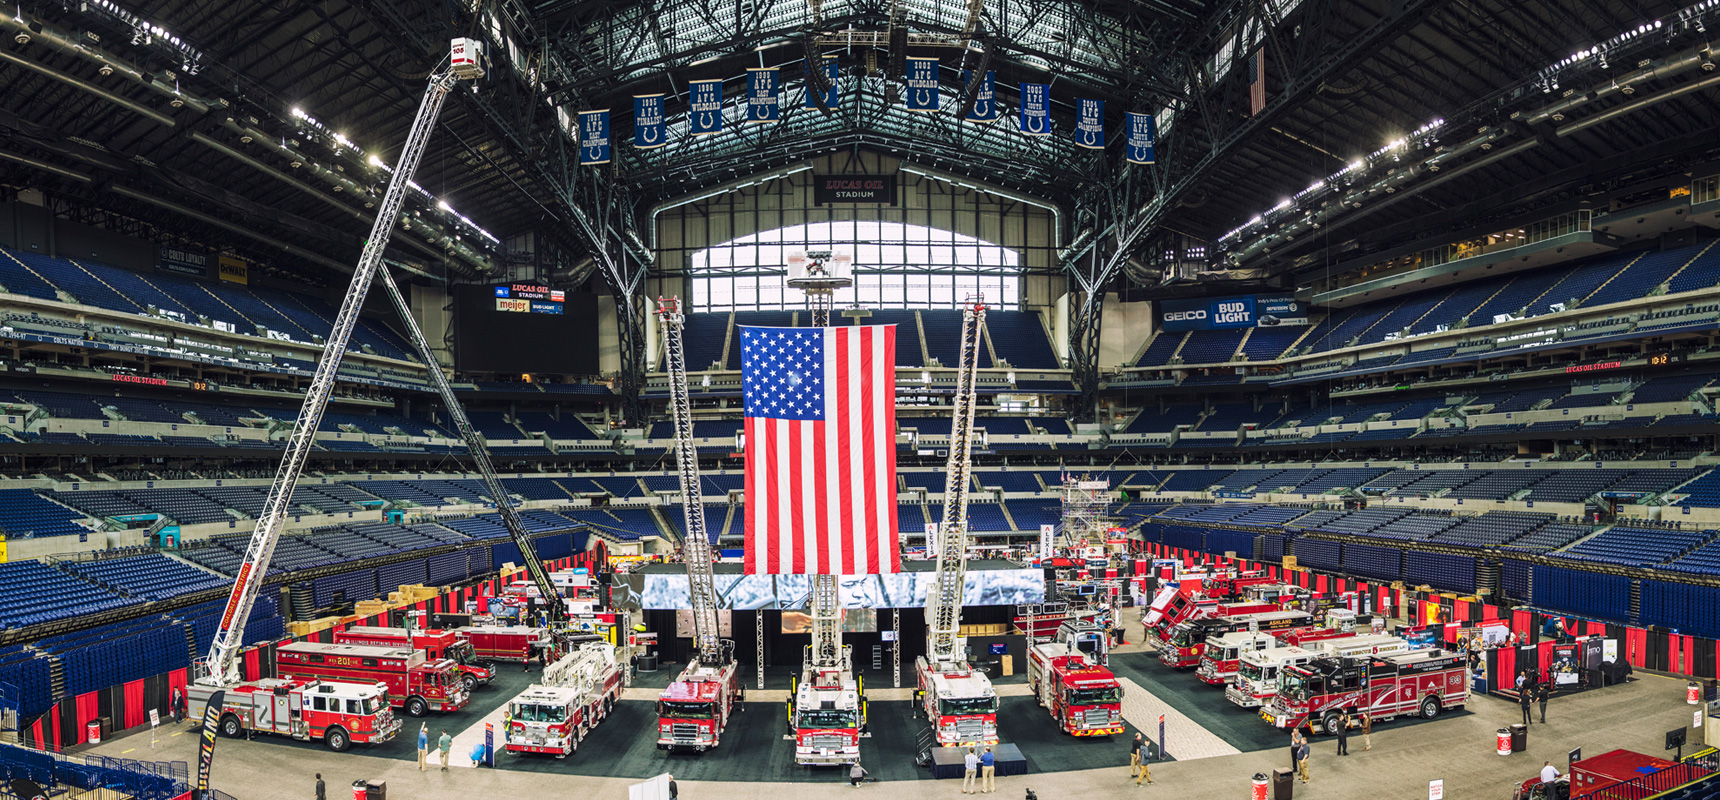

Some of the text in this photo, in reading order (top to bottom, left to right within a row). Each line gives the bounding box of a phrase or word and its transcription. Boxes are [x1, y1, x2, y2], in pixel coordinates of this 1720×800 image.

[915, 71, 930, 80] AFC
[754, 79, 771, 90] AFC
[908, 80, 938, 88] WILDCARD
[1027, 86, 1042, 94] 2003
[697, 93, 714, 102] AFC
[750, 97, 776, 105] CHAMPIONS
[1027, 94, 1043, 103] AFC
[692, 102, 720, 112] WILDCARD
[1083, 100, 1097, 108] 2004
[641, 107, 658, 116] AFC
[1082, 107, 1098, 118] AFC
[637, 116, 662, 126] FINALIST
[1133, 116, 1147, 124] 2005
[586, 121, 602, 132] AFC
[1078, 123, 1102, 133] CHAMPIONS
[1133, 123, 1148, 134] AFC
[582, 138, 607, 147] CHAMPIONS
[1129, 138, 1152, 148] CHAMPIONS
[826, 180, 884, 189] LUCAS OIL
[168, 249, 184, 262] COLTS
[186, 253, 206, 265] LOYALTY
[512, 284, 536, 292] LUCAS
[500, 300, 526, 310] meijer
[1218, 302, 1244, 313] BUD
[1164, 310, 1206, 321] GEICO
[1214, 312, 1250, 323] LIGHT
[1593, 361, 1620, 370] STADIUM
[142, 377, 167, 386] STADIUM
[223, 599, 236, 628] COALDALE
[237, 564, 249, 592] DISTRICT
[337, 657, 350, 665] 201
[1449, 675, 1461, 685] 33
